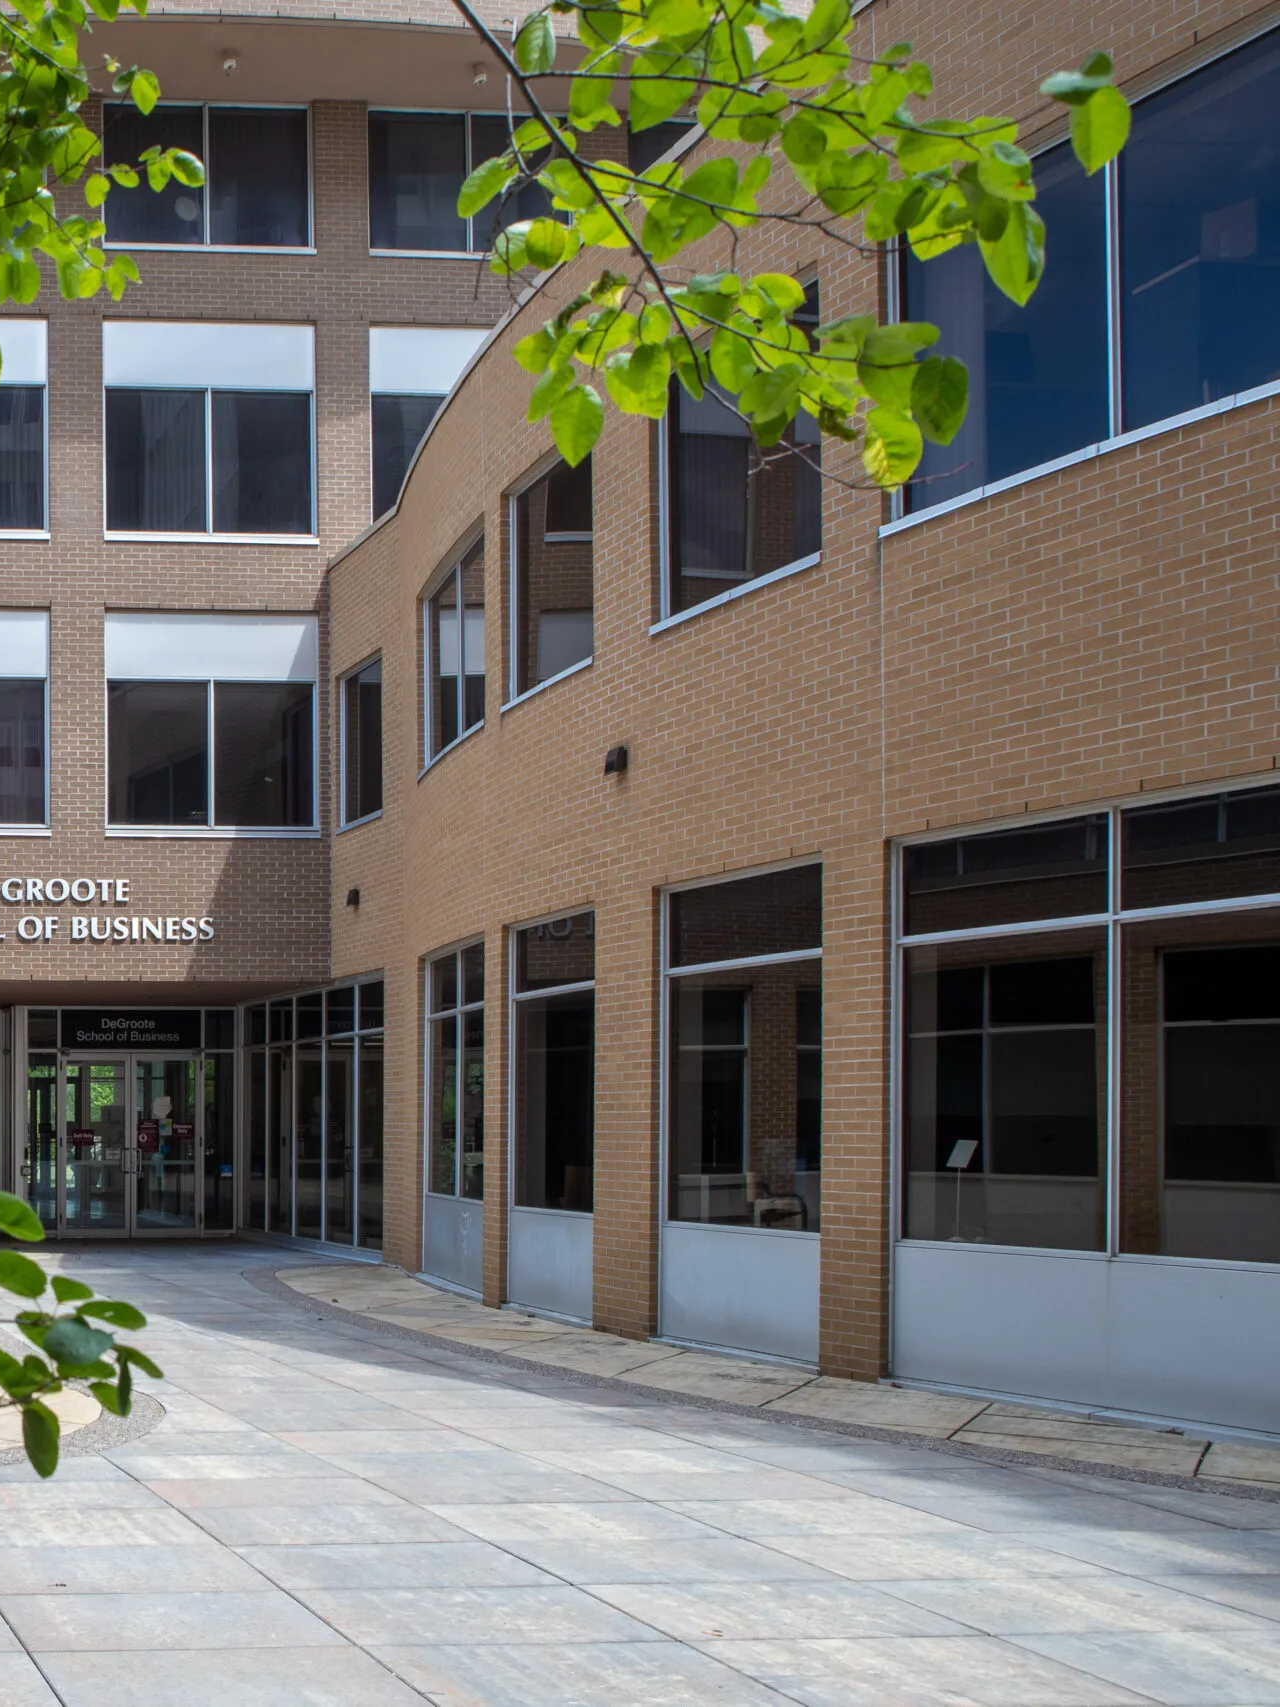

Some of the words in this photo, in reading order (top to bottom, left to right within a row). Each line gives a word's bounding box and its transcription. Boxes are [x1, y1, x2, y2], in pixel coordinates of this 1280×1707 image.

[17, 915, 59, 940] OF
[71, 916, 215, 941] BUSINESS
[101, 1018, 156, 1029] DeGroote
[76, 1030, 114, 1041] School
[117, 1031, 128, 1041] of
[130, 1031, 180, 1041] Business
